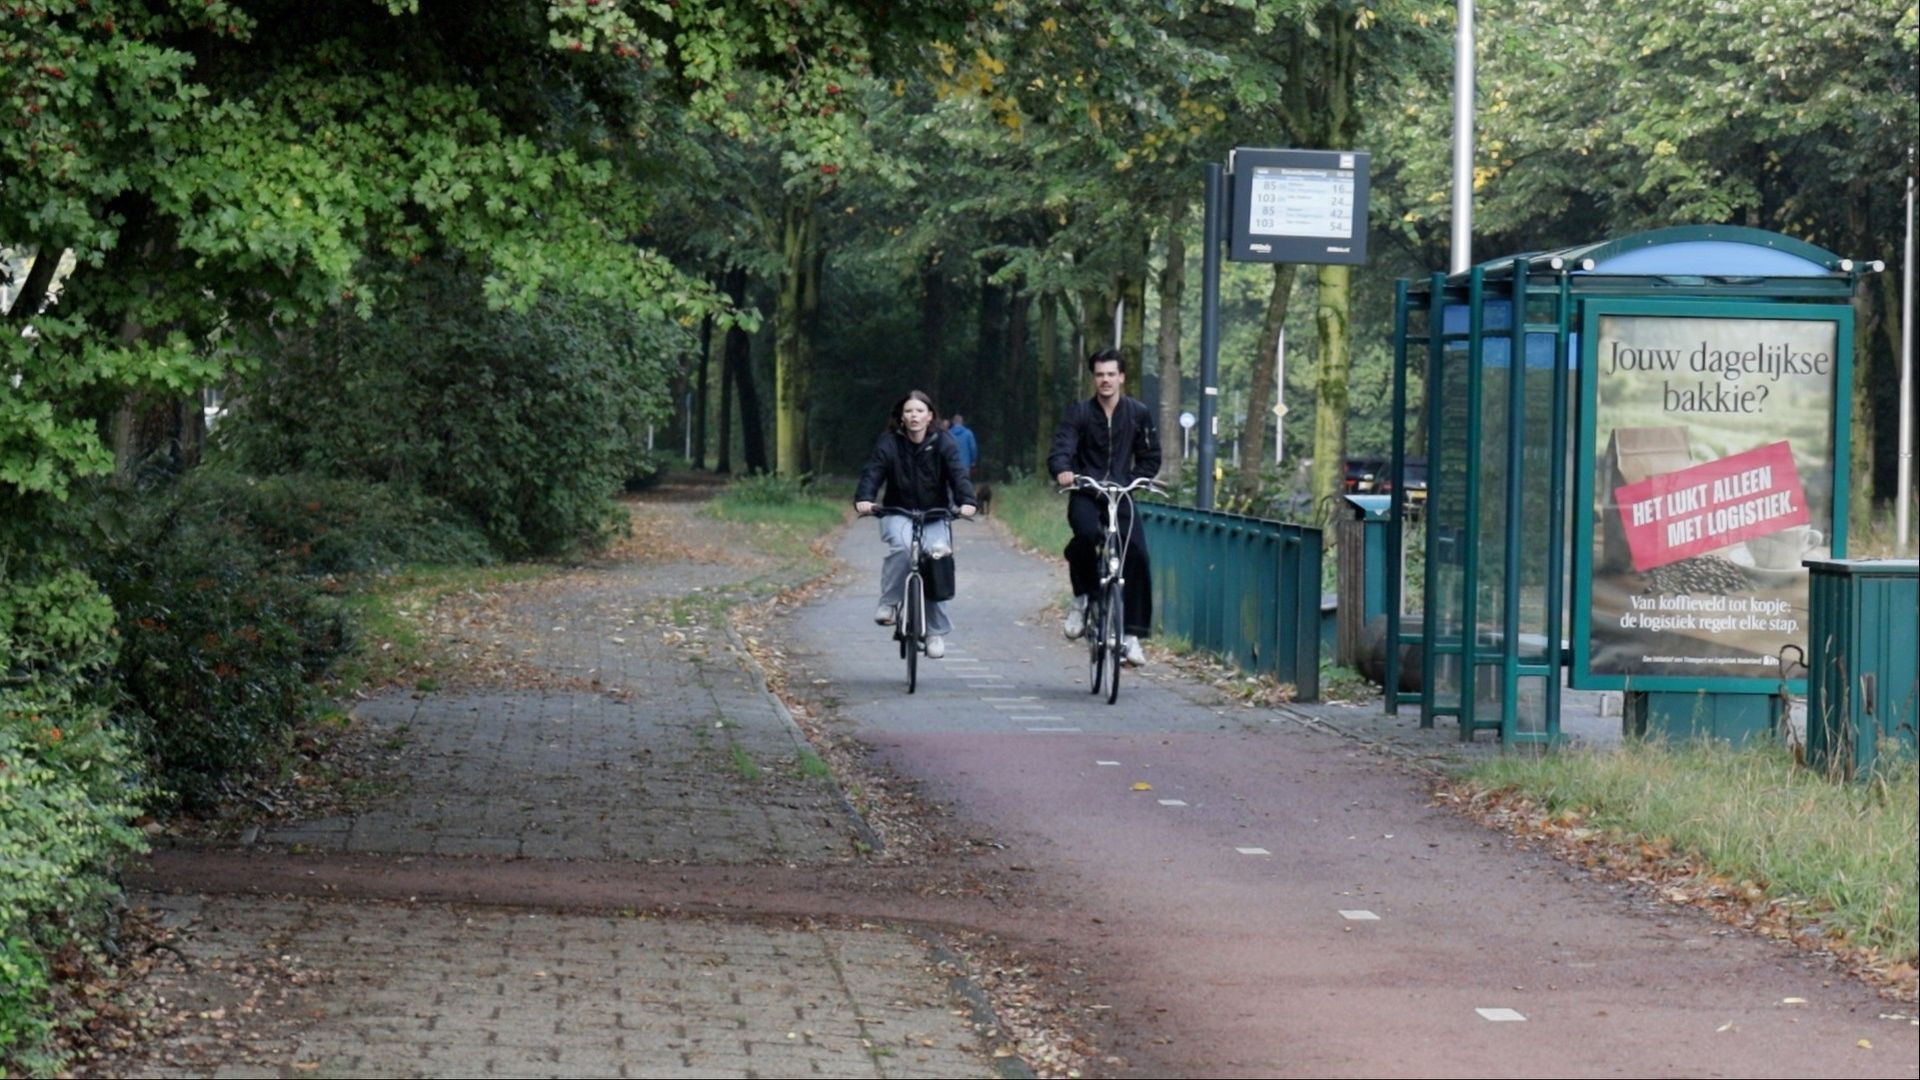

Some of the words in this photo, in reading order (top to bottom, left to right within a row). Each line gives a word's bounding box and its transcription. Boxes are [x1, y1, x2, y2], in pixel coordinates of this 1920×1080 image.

[1263, 181, 1276, 190] 85
[1332, 184, 1345, 193] 16
[1257, 194, 1276, 203] 103
[1331, 197, 1344, 206] 24
[1262, 206, 1275, 215] 85
[1330, 209, 1343, 219] 42
[1256, 218, 1274, 228] 103
[1330, 221, 1342, 231] 54
[1607, 341, 1681, 375] Jouw
[1689, 341, 1829, 381] dagelijkse
[1663, 380, 1769, 413] bakkie?
[1632, 496, 1663, 527] HET
[1667, 483, 1708, 517] LUKT
[1713, 465, 1772, 504] ALLEEN
[1667, 515, 1703, 548] MET
[1707, 490, 1798, 536] LOGISTIEK.
[1630, 595, 1656, 610] Van
[1659, 595, 1726, 611] koffieveld
[1729, 598, 1748, 612] tot
[1750, 597, 1792, 616] kopje:
[1620, 612, 1637, 628] de
[1639, 612, 1697, 632] logistiek
[1699, 615, 1736, 633] regelt
[1739, 615, 1767, 631] elke
[1768, 617, 1800, 634] stap.
